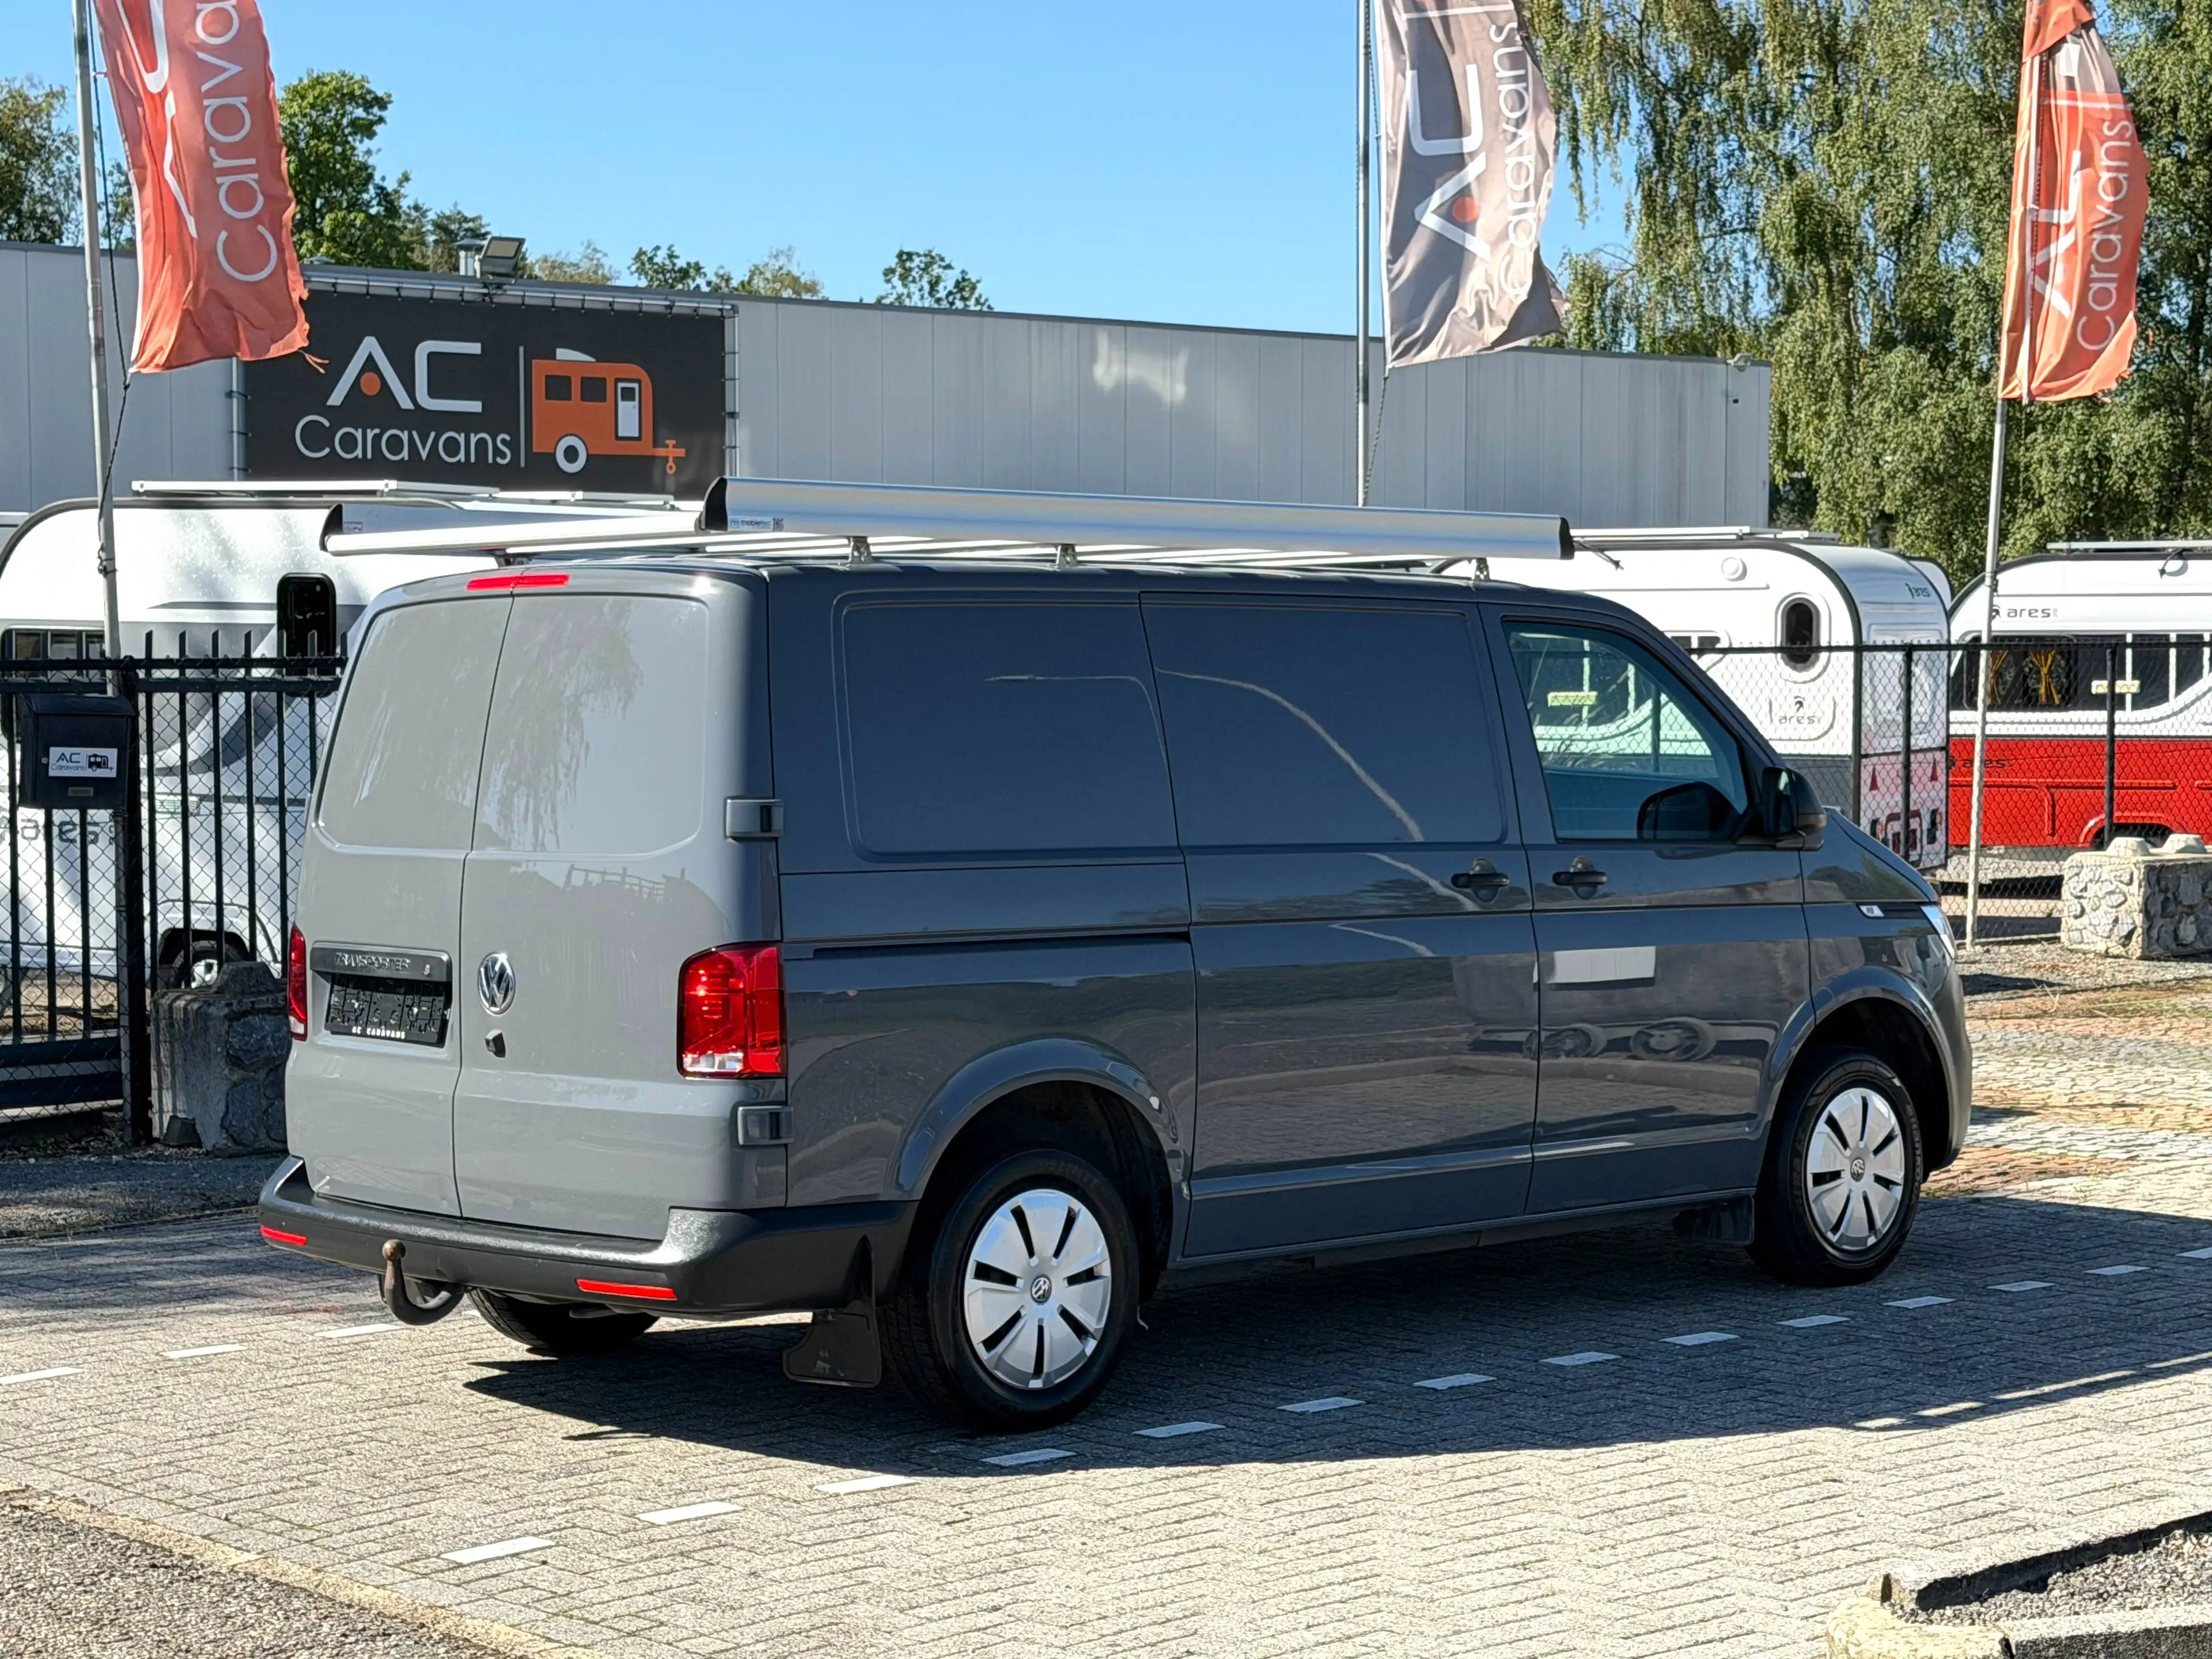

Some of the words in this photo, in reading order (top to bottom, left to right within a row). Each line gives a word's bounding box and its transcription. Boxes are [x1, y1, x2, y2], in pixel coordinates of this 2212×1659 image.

[1490, 22, 1537, 301] Caravans
[2077, 119, 2132, 351] Caravans
[326, 336, 482, 413] AC
[294, 414, 512, 465] Caravans
[2007, 608, 2051, 619] ares
[56, 752, 81, 764] AC
[351, 1025, 362, 1035] AC
